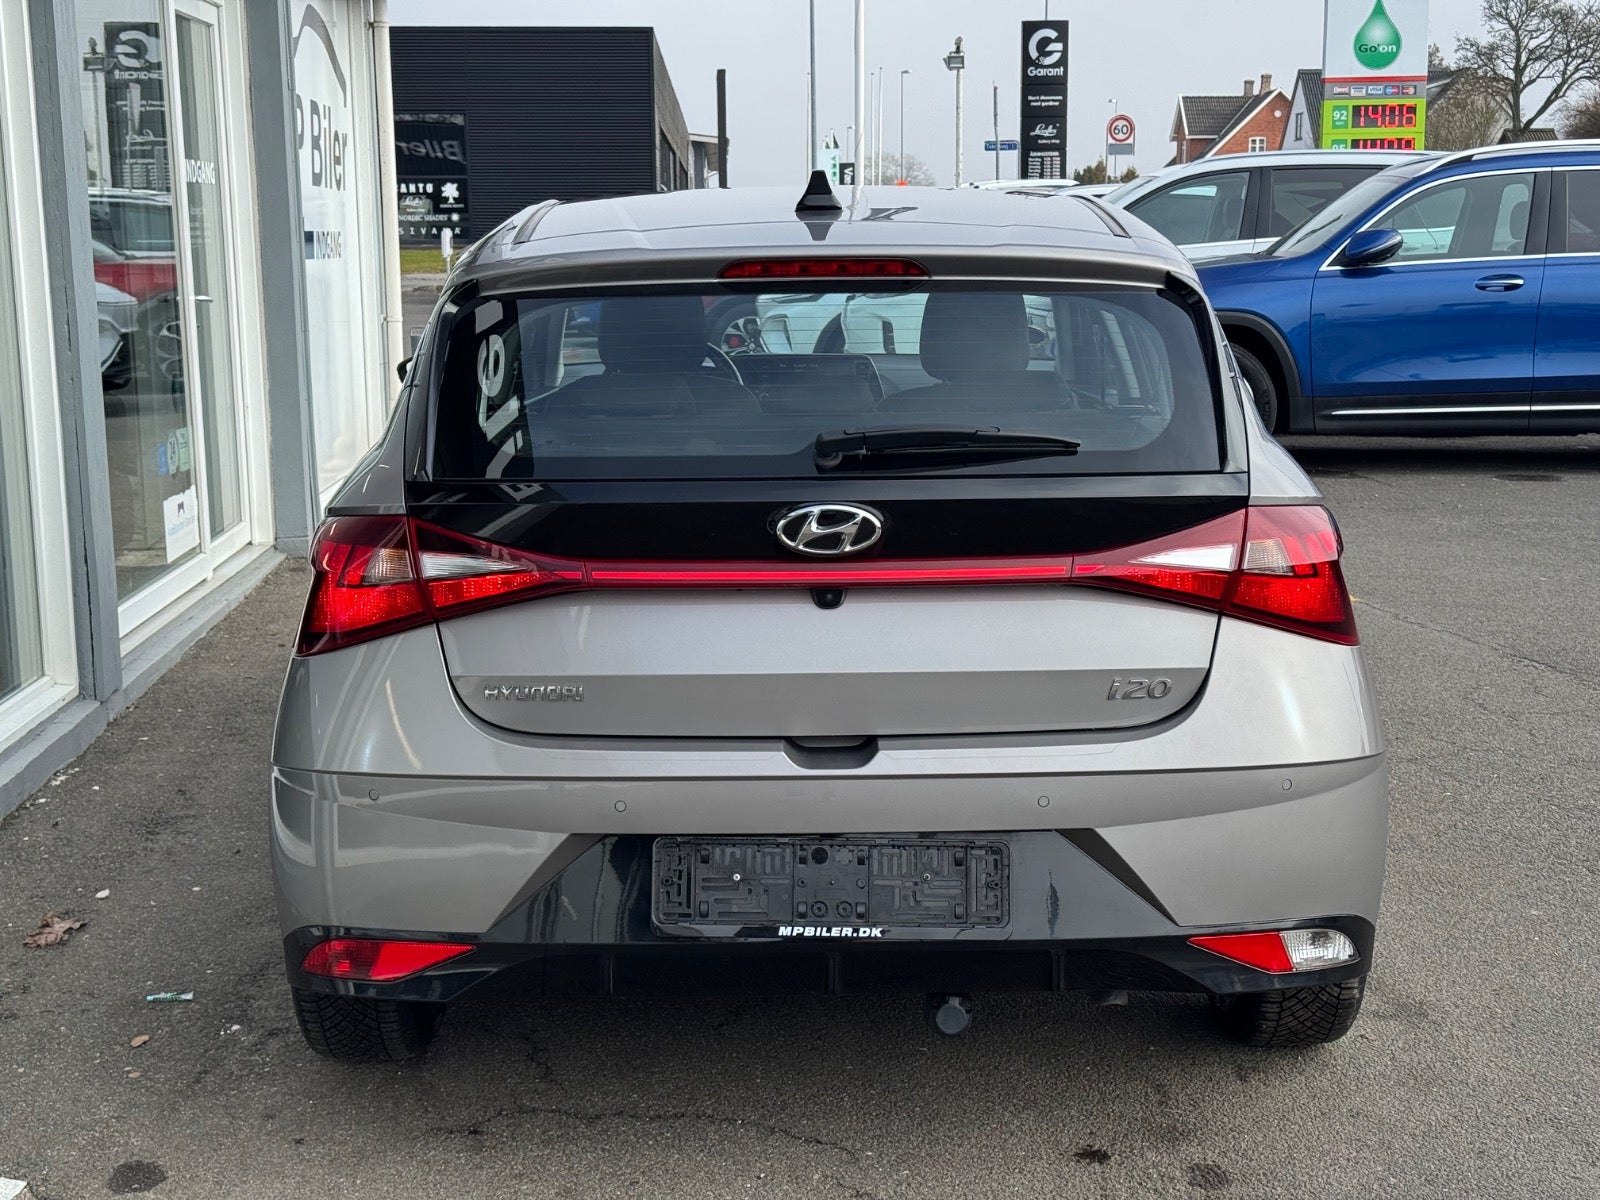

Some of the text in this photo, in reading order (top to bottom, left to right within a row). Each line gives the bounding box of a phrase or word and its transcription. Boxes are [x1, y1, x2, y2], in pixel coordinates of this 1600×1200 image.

[1358, 43, 1397, 53] Go'on
[1027, 66, 1064, 76] Garant
[1333, 110, 1348, 120] 92
[1113, 124, 1129, 135] 60
[310, 99, 347, 192] Biler
[397, 182, 434, 193] ANTO
[398, 227, 461, 235] SIVAA
[315, 230, 342, 260] INDGANG
[484, 685, 584, 702] HYUNDAI
[1108, 676, 1172, 700] i20
[778, 926, 883, 937] MPBILER.DK
